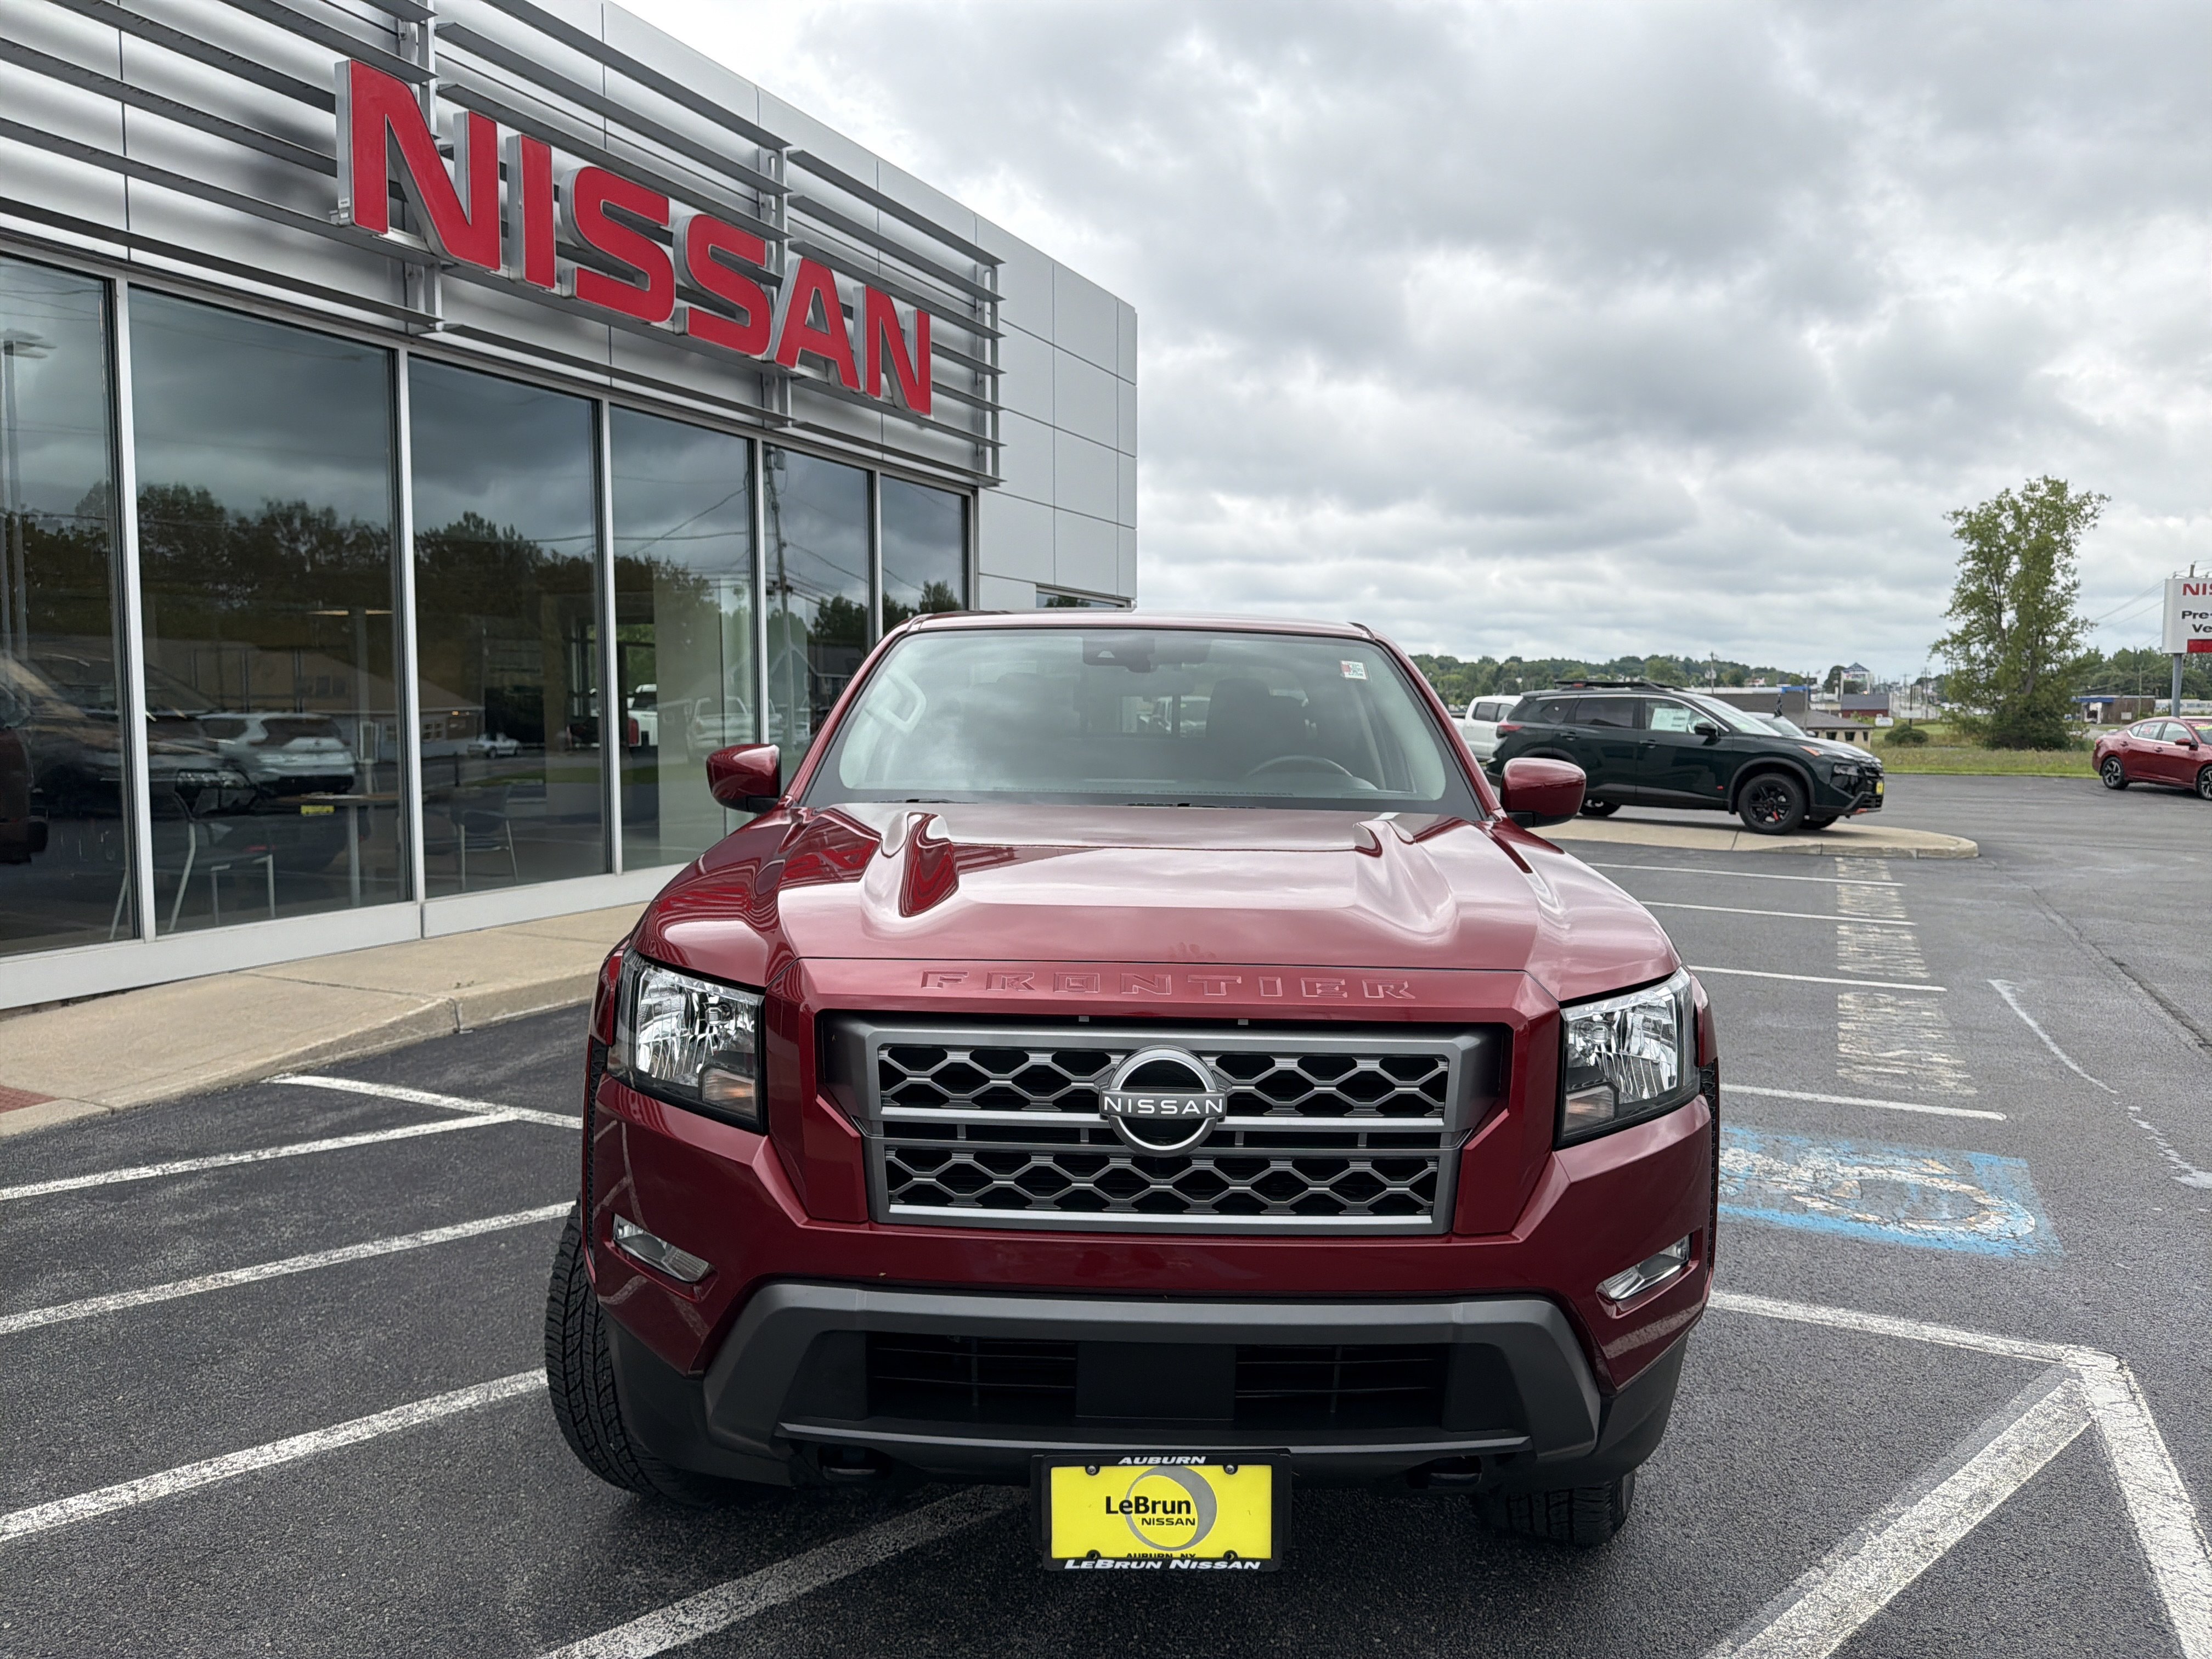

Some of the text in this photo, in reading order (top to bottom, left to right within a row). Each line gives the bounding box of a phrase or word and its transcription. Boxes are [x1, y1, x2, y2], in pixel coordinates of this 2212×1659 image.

[336, 59, 932, 416] NISSAN
[2183, 583, 2212, 596] NI
[921, 970, 1415, 999] FRONTIER
[1104, 1096, 1222, 1114] NISSAN
[1118, 1456, 1206, 1464] AUBURN
[1105, 1496, 1191, 1514] LeBrun
